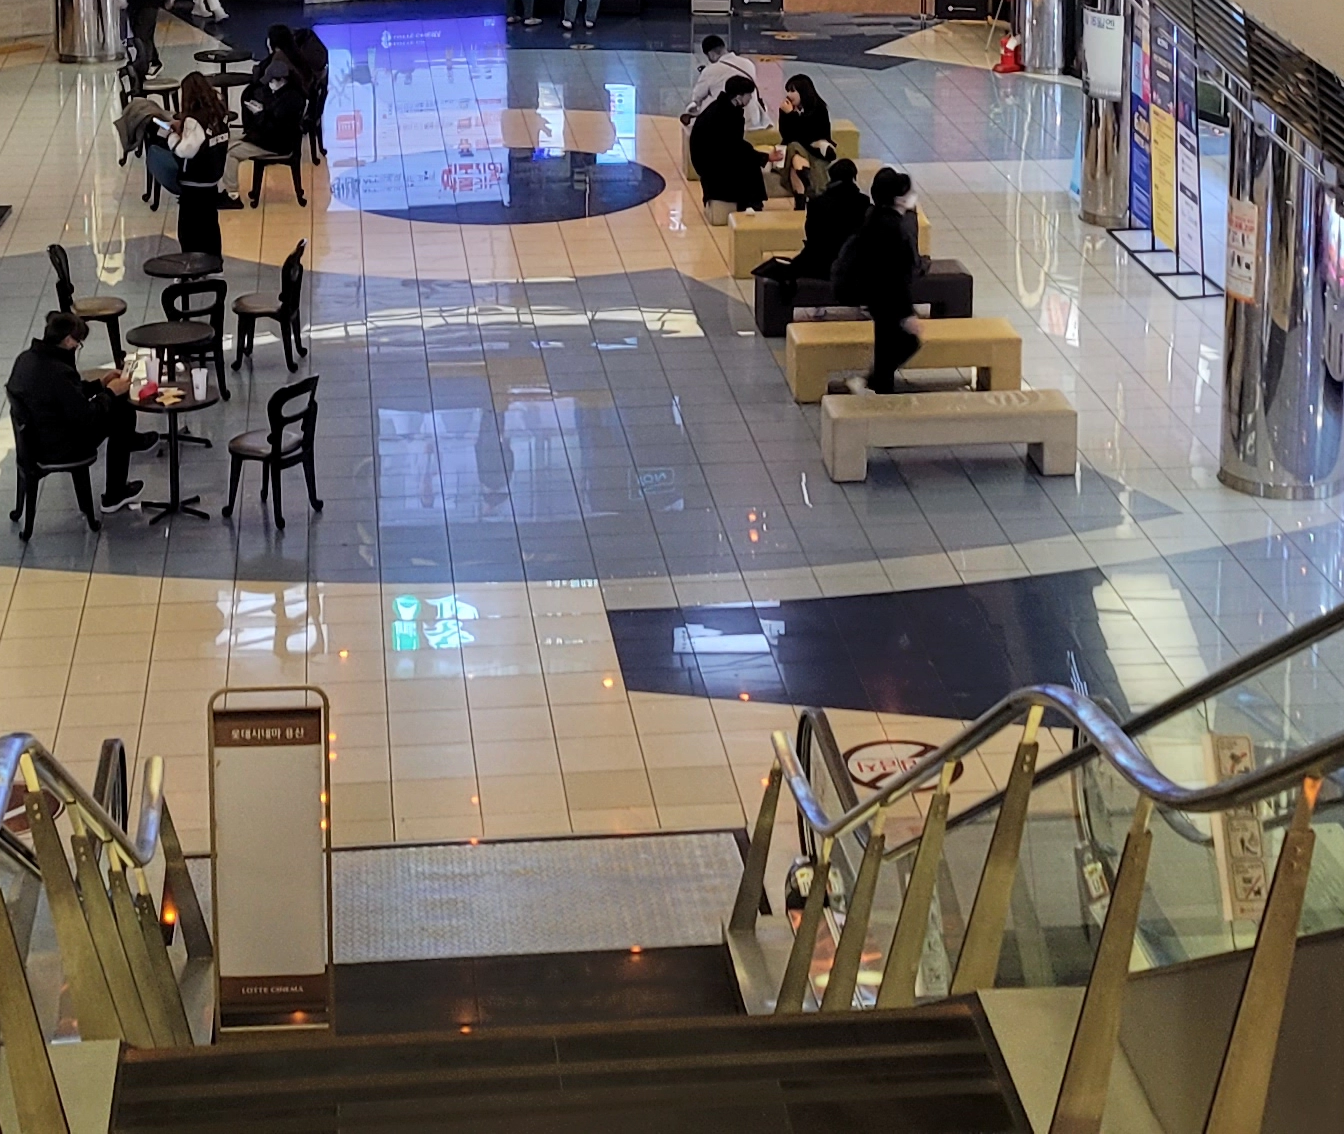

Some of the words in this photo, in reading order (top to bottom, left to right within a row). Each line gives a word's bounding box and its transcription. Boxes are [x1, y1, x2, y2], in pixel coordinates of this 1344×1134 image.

[231, 728, 281, 740] 롯데시네마
[286, 727, 305, 739] 용산
[241, 986, 269, 995] LOTTE
[270, 985, 305, 995] CINEMA
